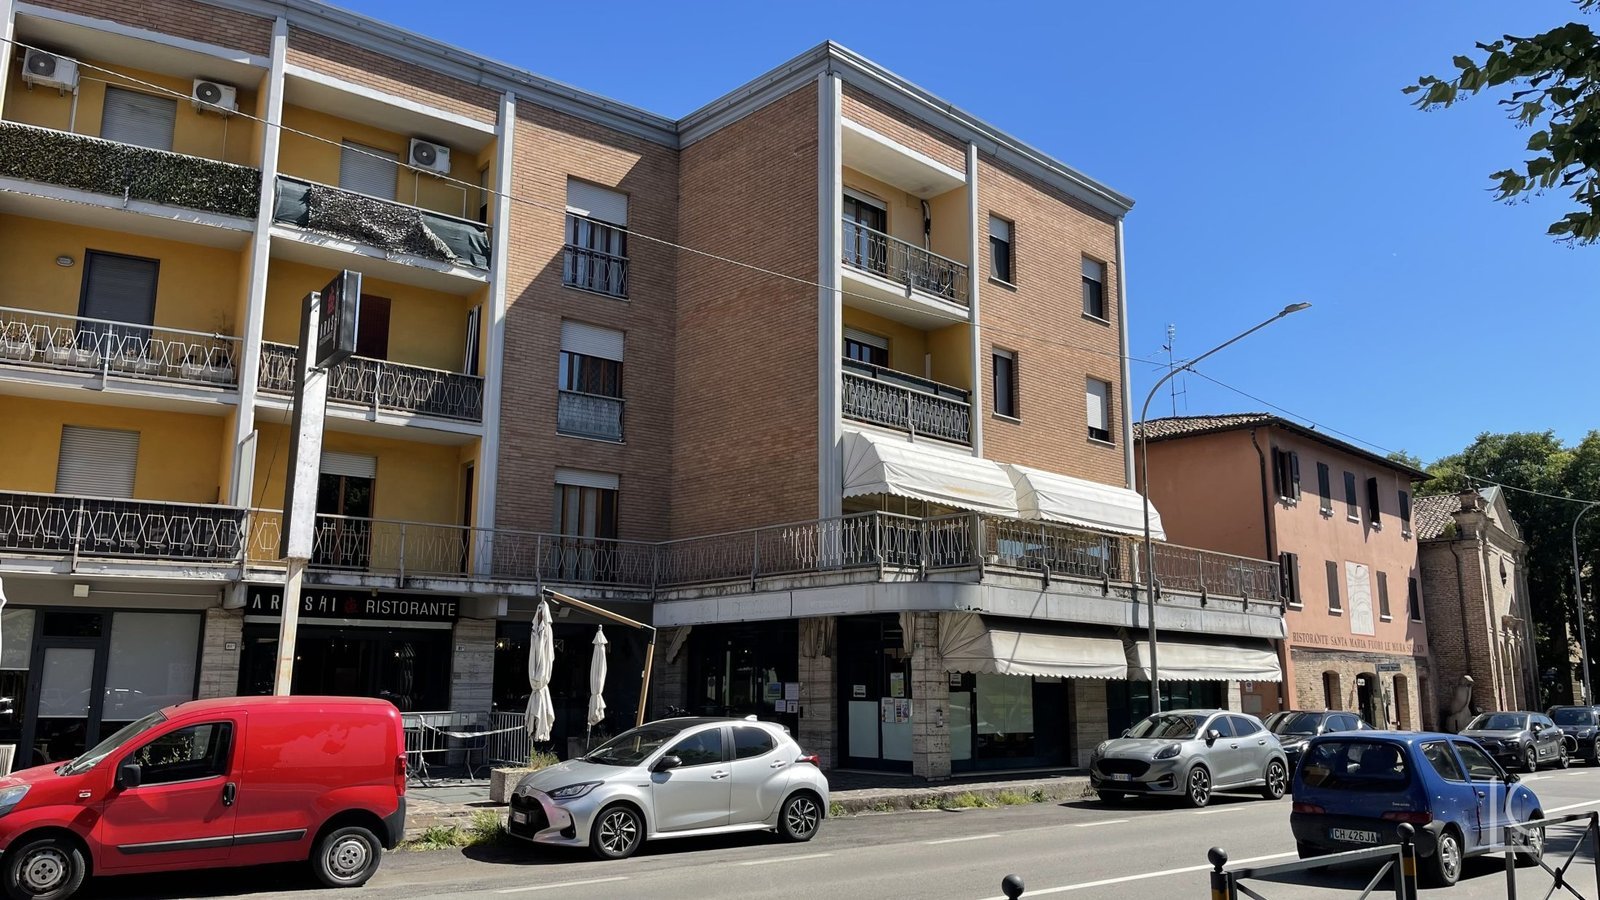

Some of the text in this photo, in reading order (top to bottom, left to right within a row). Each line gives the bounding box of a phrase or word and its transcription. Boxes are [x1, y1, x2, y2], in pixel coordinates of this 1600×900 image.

[252, 593, 456, 616] ARSHI RISTORANTE
[1292, 632, 1329, 645] RISTORANTE
[1330, 635, 1348, 647] SANTA
[1349, 637, 1367, 649] MARIA
[1334, 829, 1346, 839] CH
